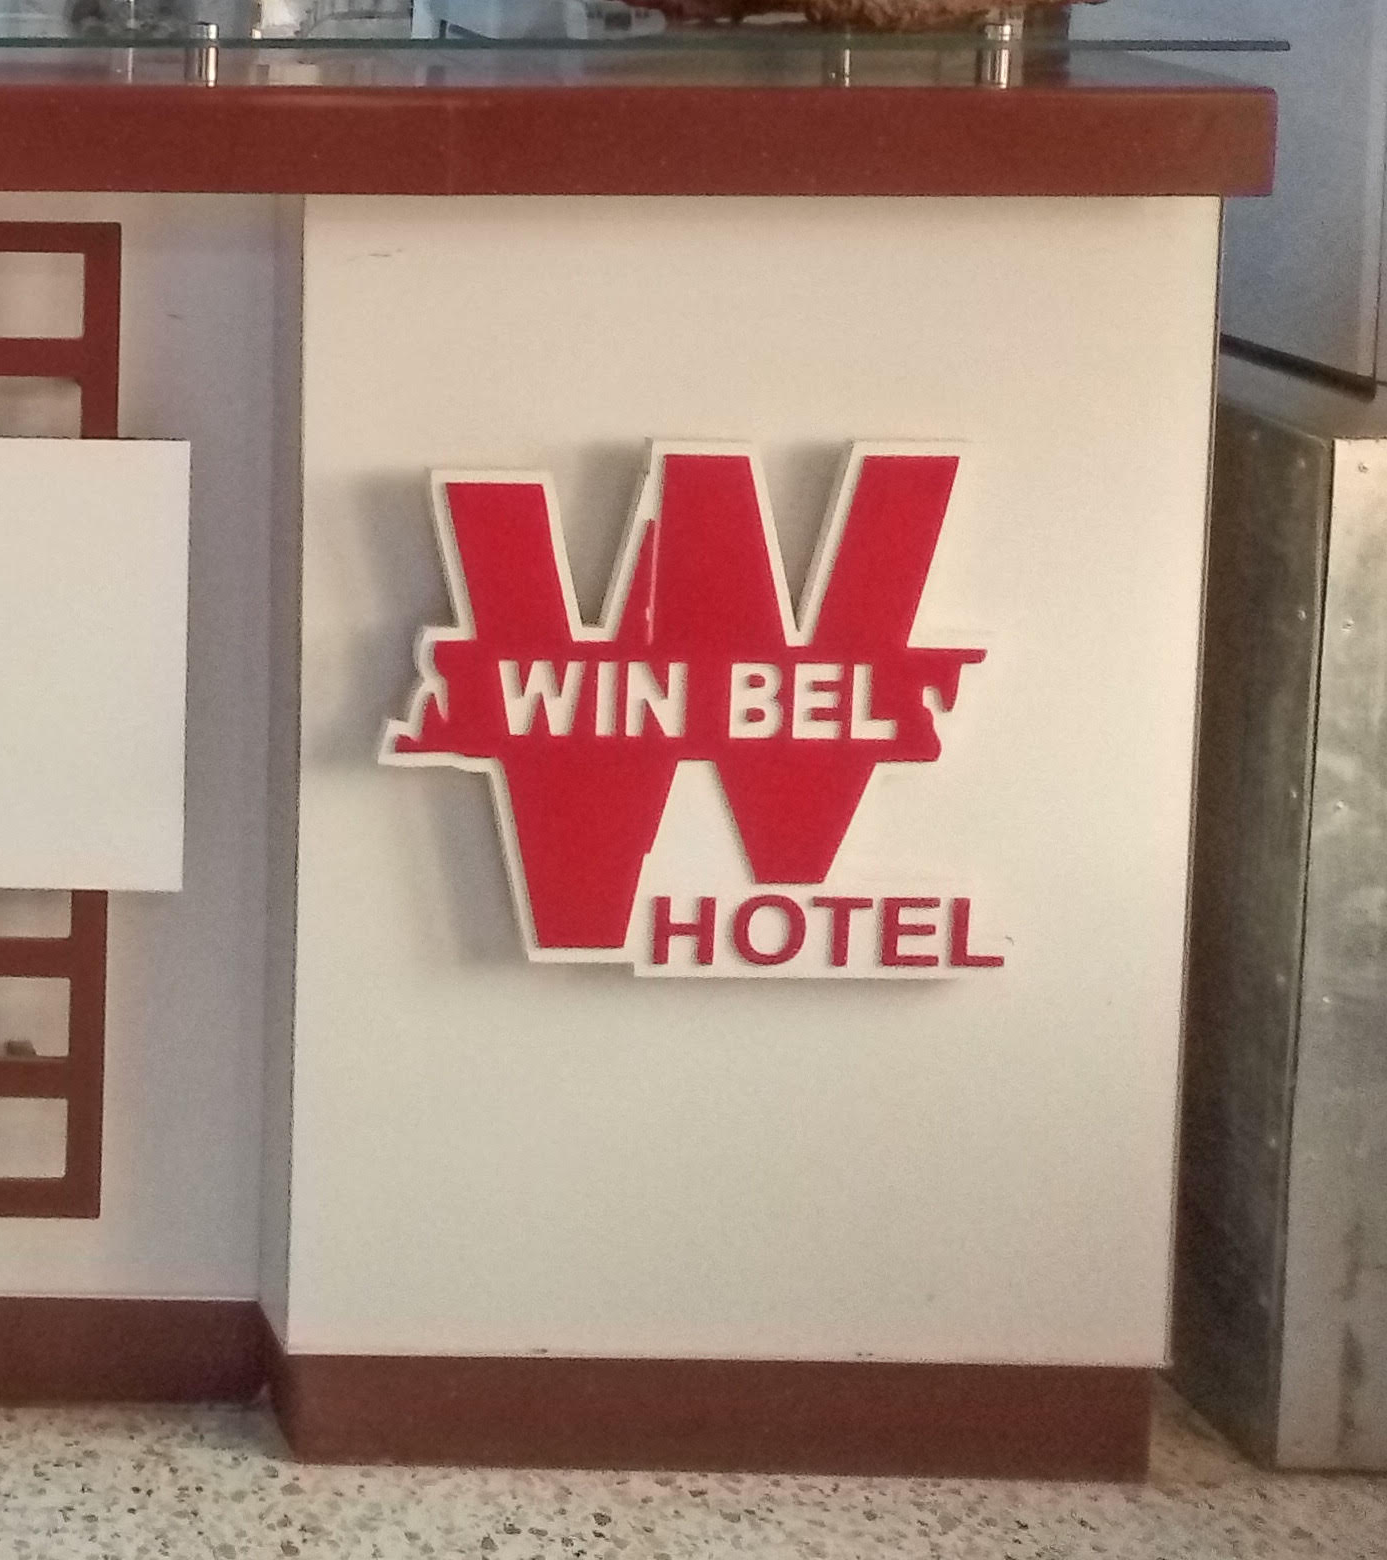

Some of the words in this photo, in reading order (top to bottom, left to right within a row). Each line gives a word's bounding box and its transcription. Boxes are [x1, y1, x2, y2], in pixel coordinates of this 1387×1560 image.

[498, 659, 689, 737] WIN
[729, 662, 898, 741] BEL
[651, 894, 1005, 969] HOTEL
